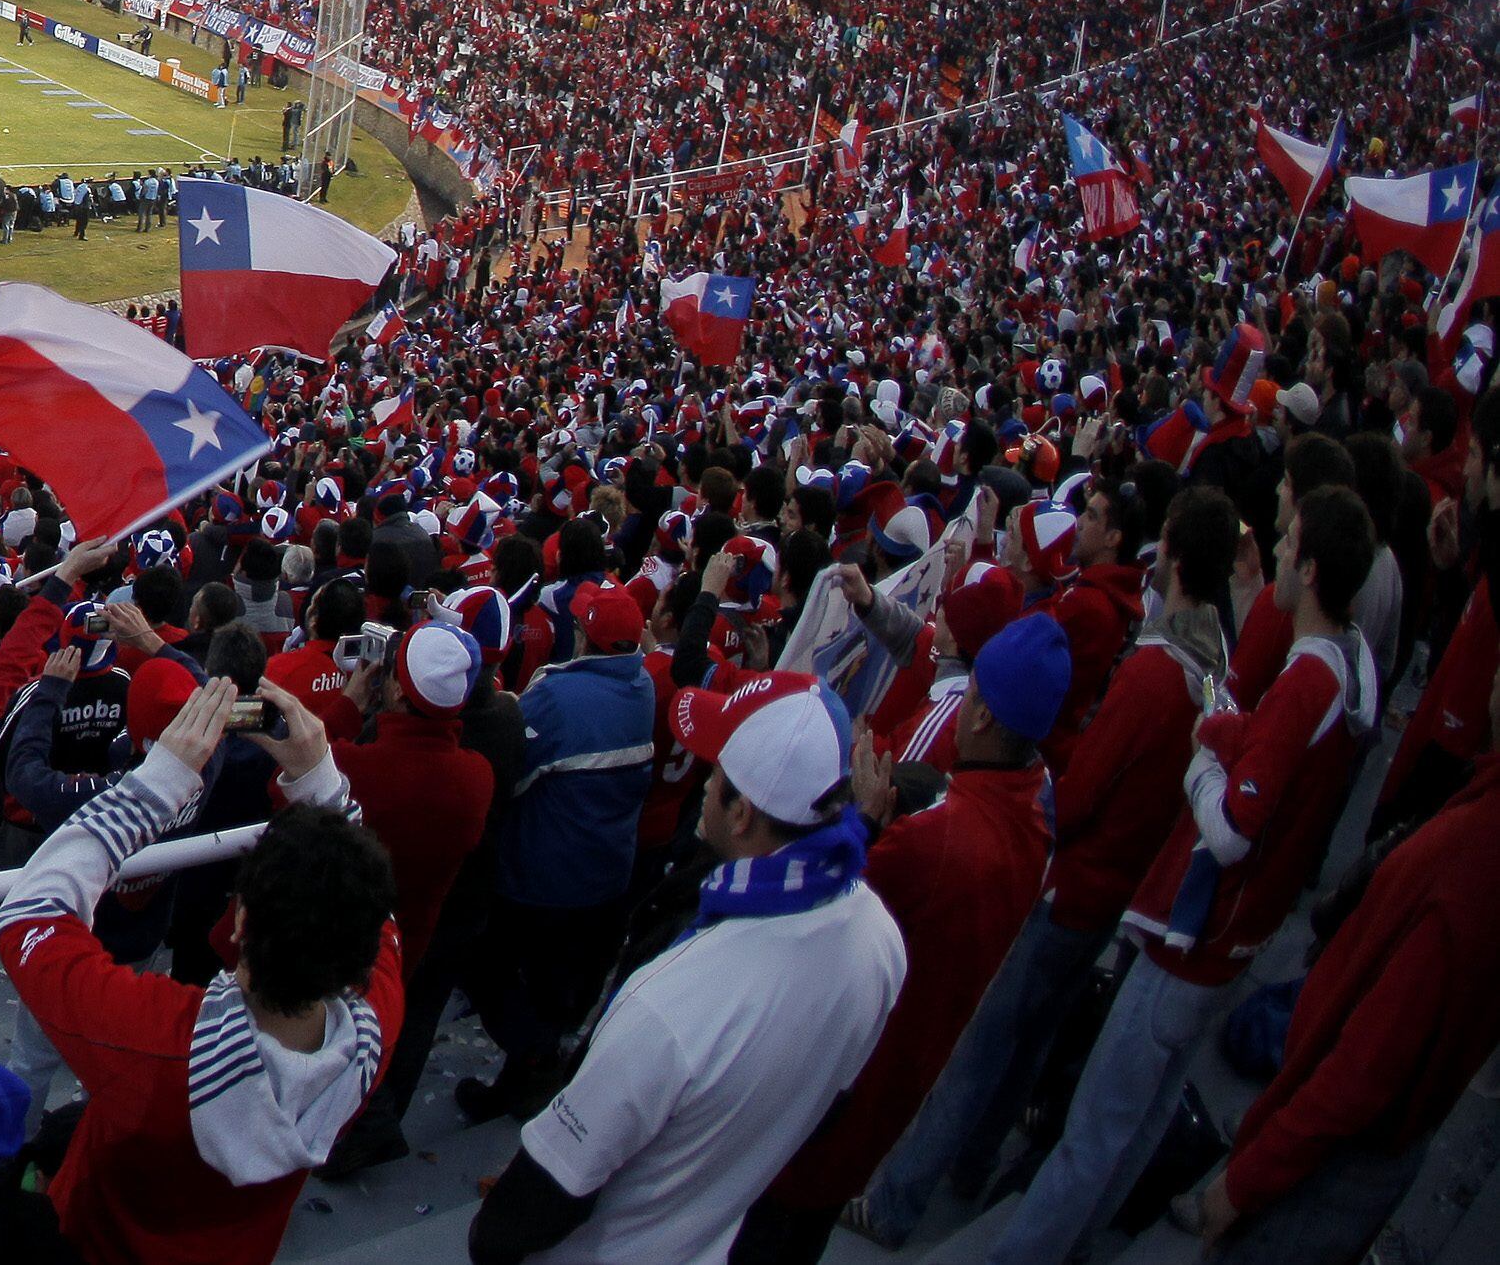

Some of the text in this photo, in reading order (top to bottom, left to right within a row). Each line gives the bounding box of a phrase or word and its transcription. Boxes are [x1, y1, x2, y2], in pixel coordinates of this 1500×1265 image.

[53, 22, 87, 49] Gillette
[172, 67, 194, 85] Buenos
[60, 698, 122, 725] moba
[677, 691, 695, 737] CHILE
